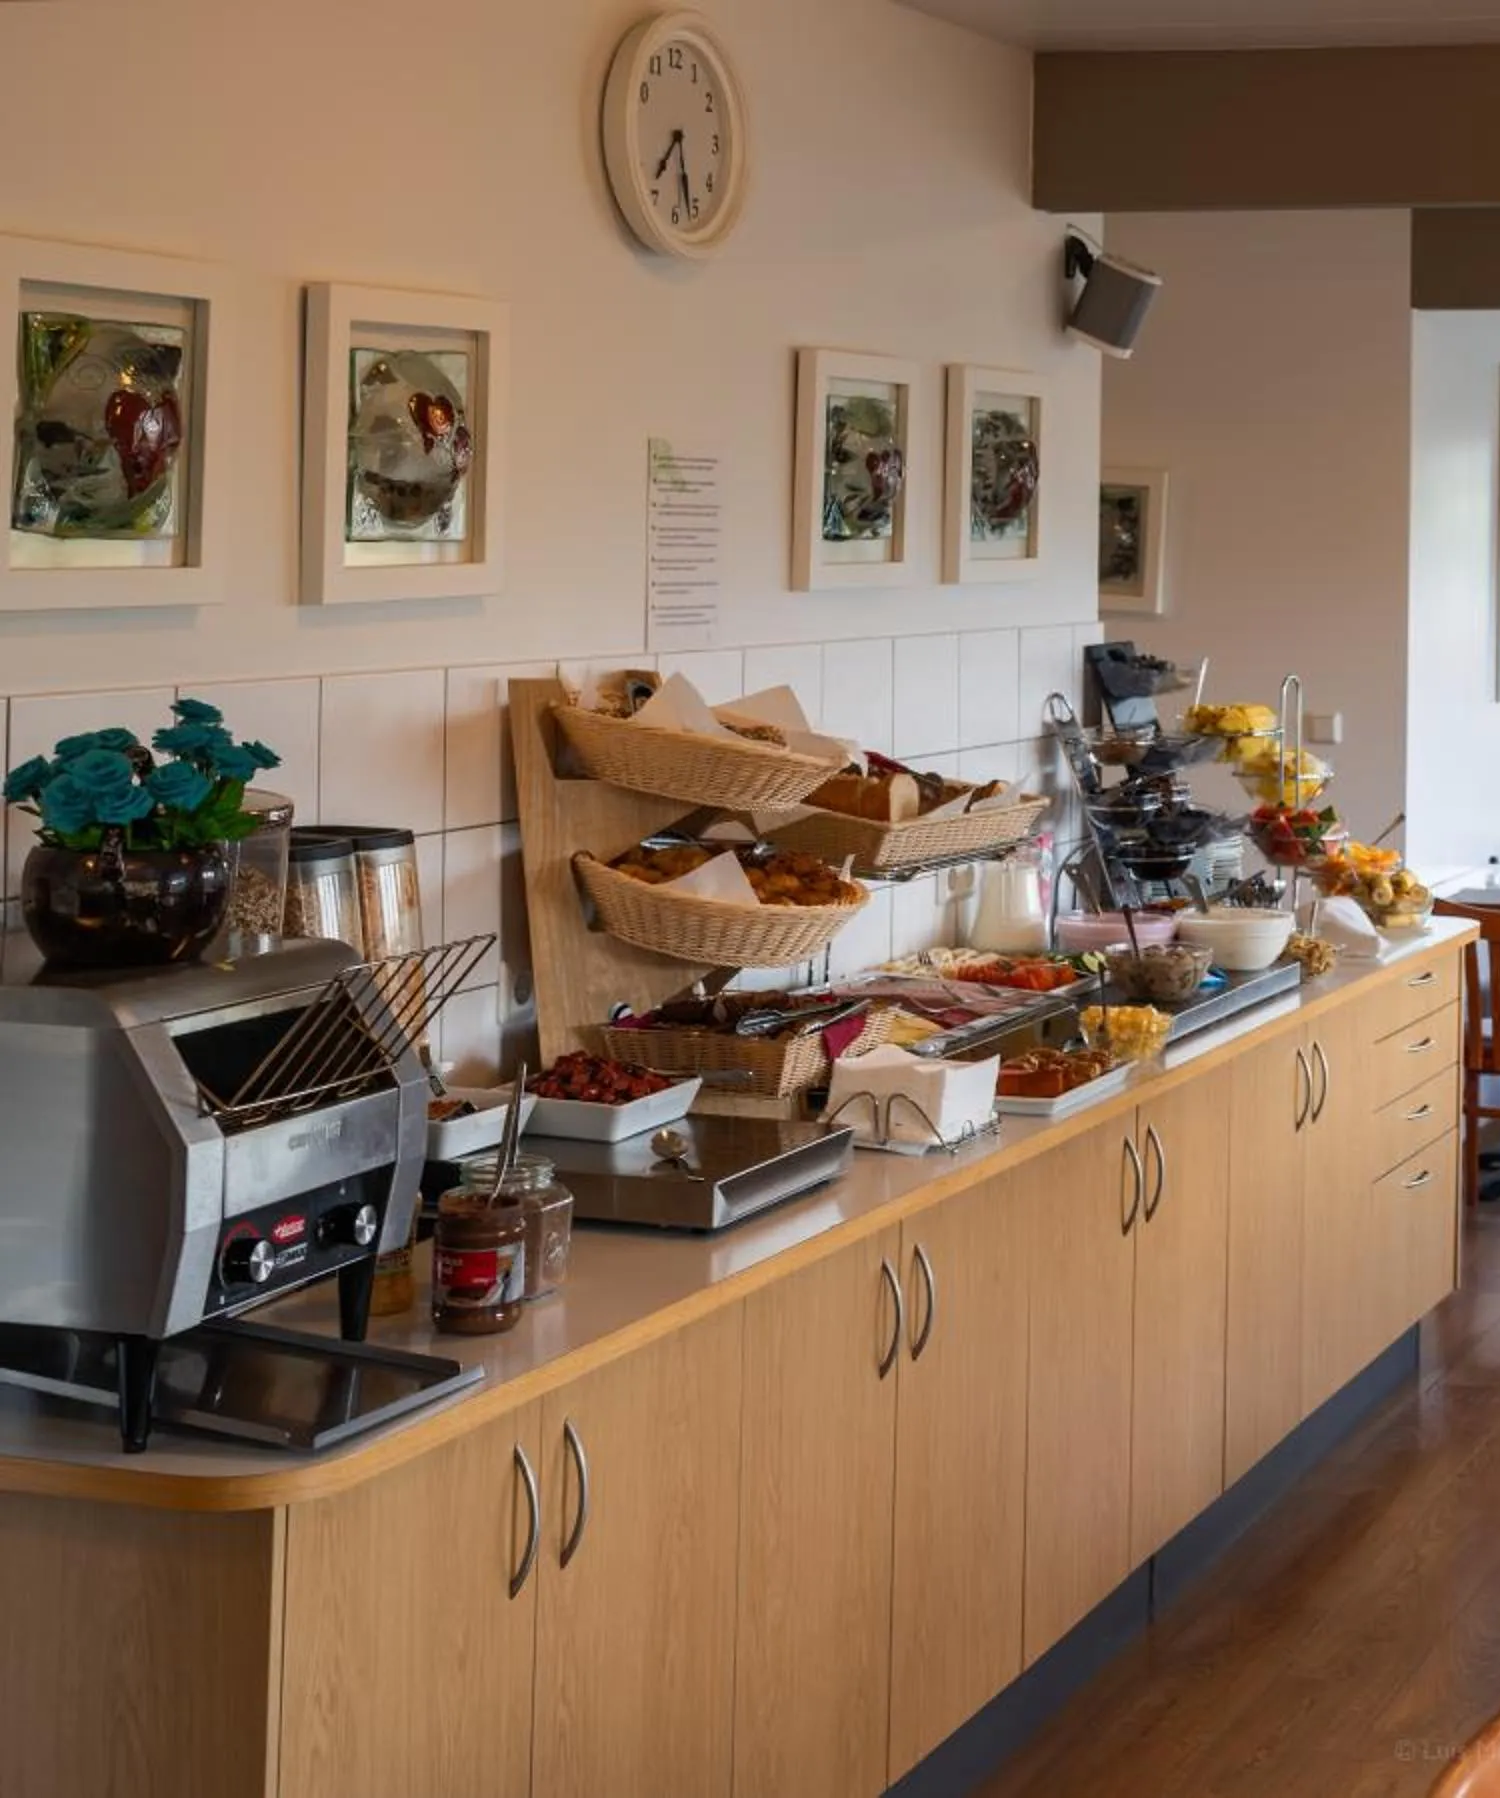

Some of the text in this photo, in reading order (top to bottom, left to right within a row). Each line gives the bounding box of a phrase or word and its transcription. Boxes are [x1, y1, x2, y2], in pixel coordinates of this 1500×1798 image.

[649, 55, 662, 77] 11
[668, 47, 683, 70] 12
[691, 63, 698, 85] 1
[705, 92, 714, 113] 2
[711, 134, 720, 155] 3
[705, 173, 714, 193] 4
[651, 190, 660, 206] 7
[691, 198, 700, 219] 5
[671, 206, 680, 225] 6
